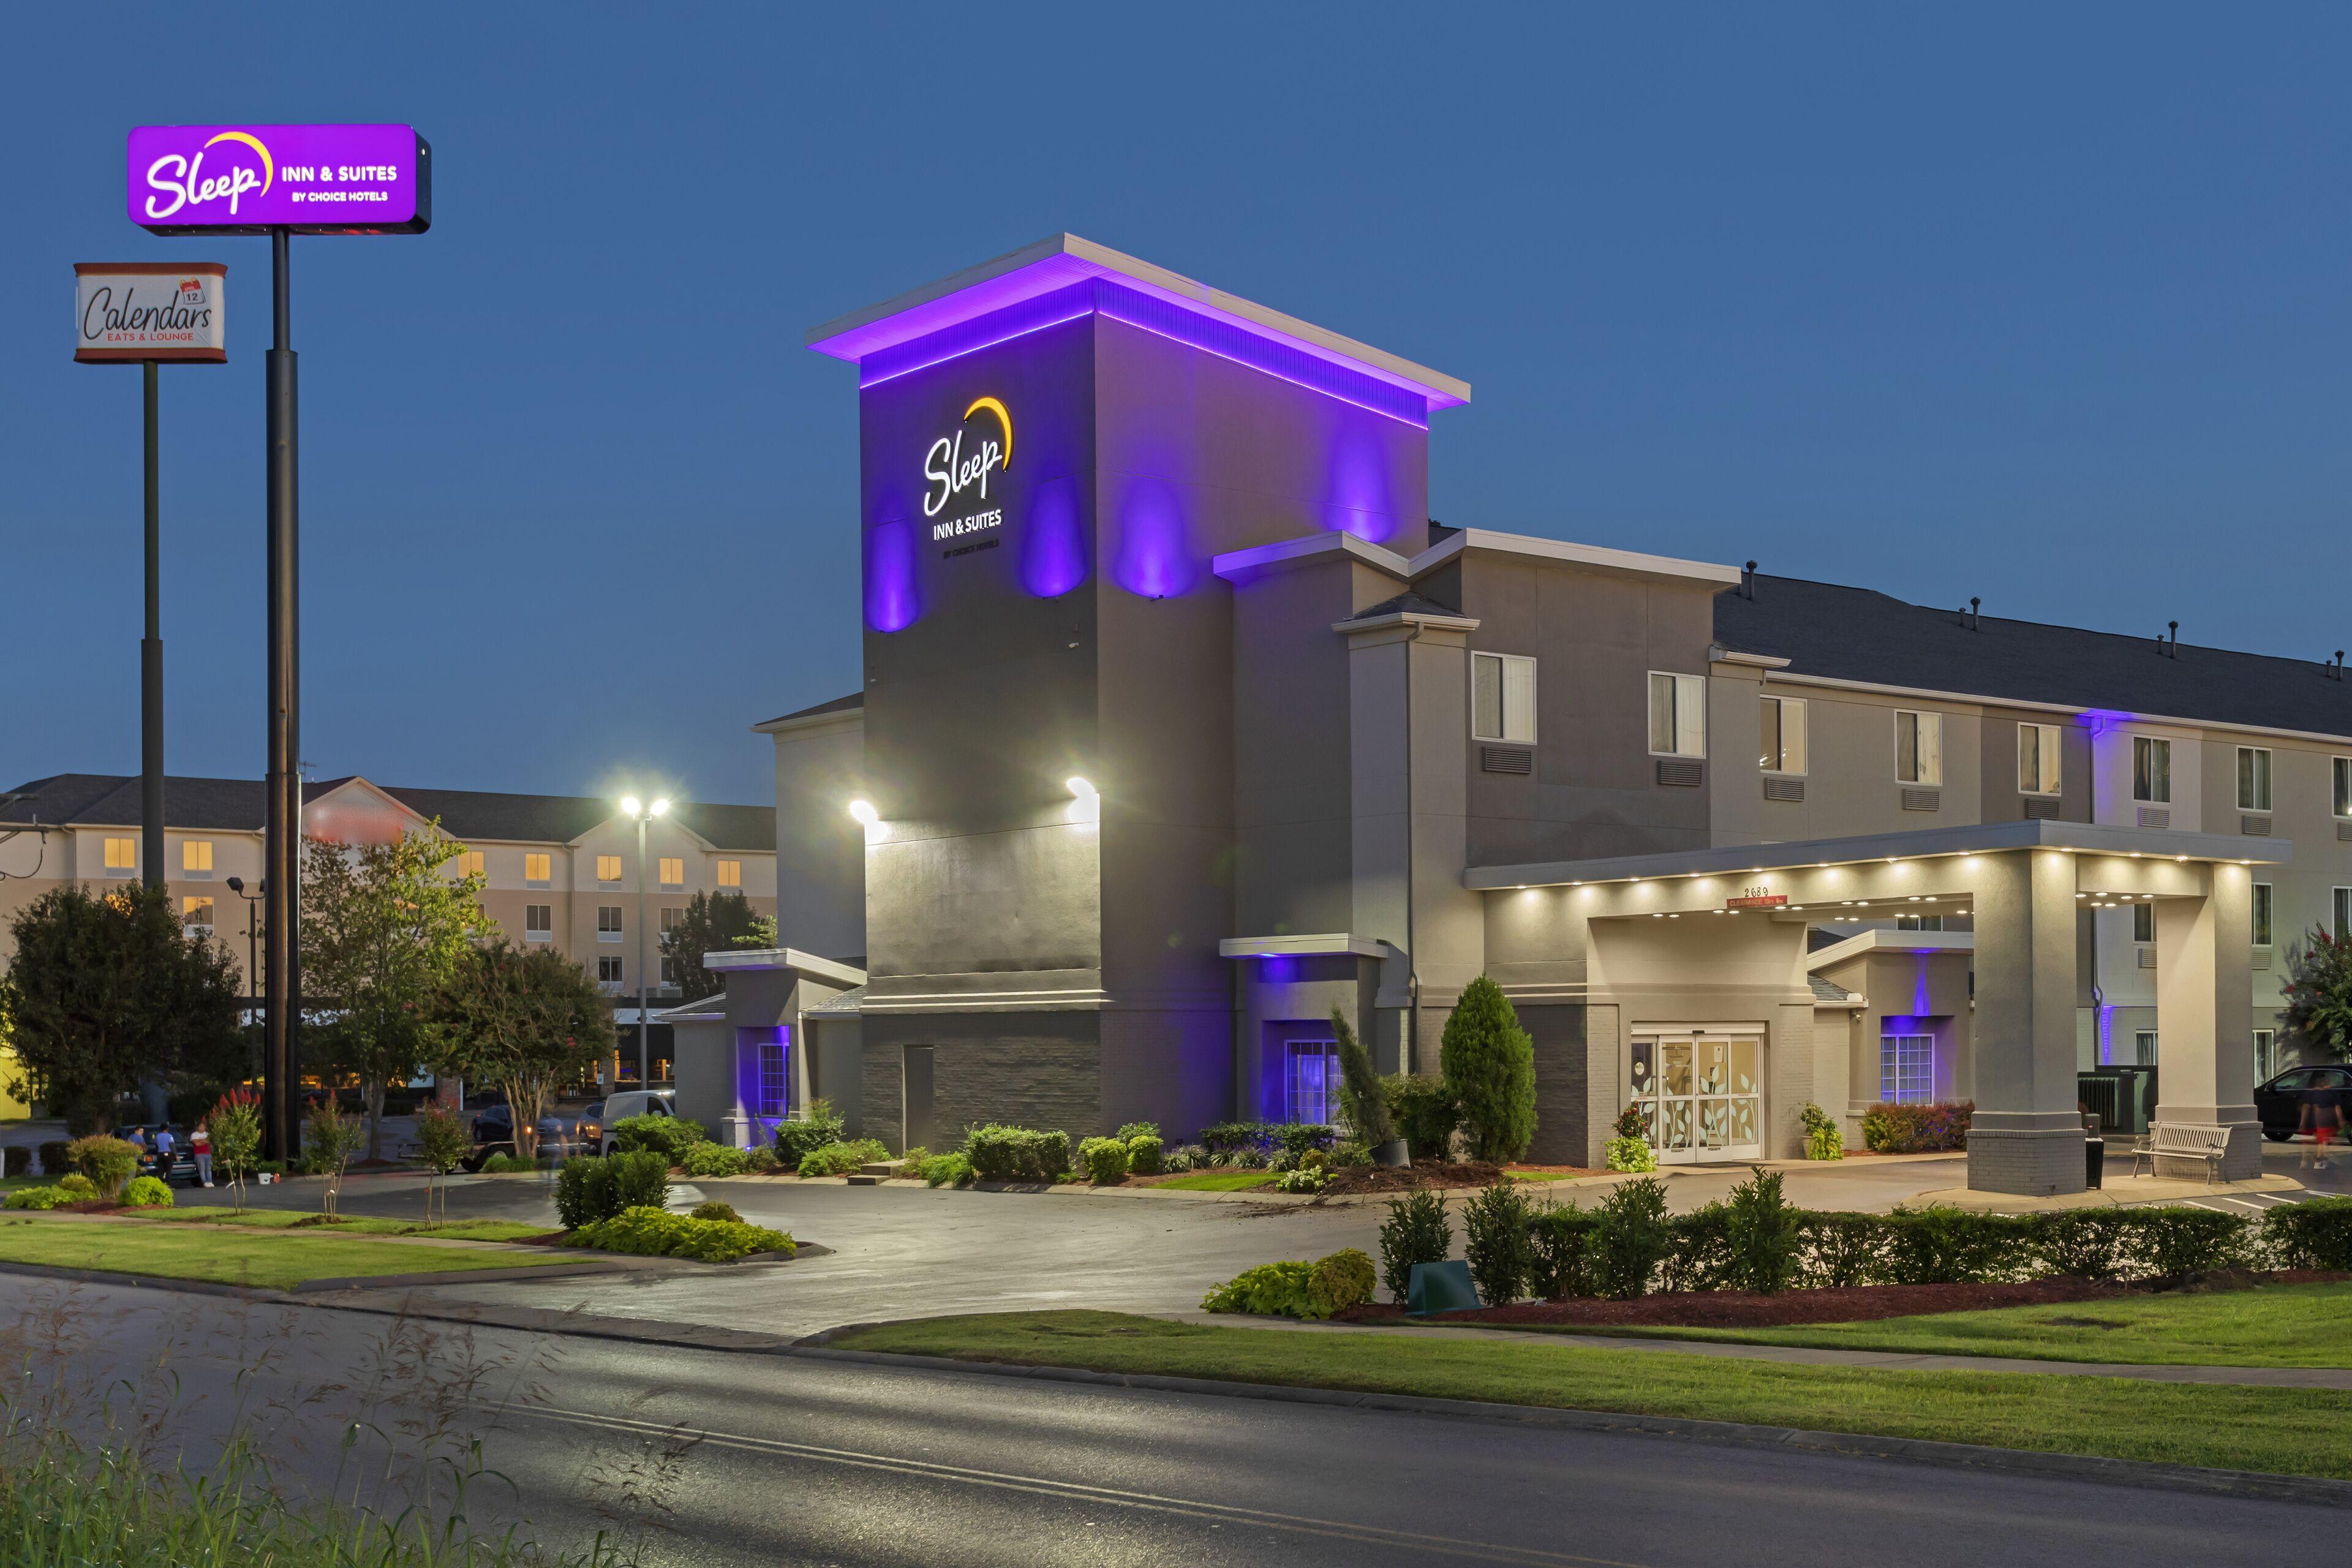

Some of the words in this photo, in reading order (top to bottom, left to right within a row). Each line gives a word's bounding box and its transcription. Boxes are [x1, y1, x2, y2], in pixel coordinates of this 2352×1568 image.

[282, 166, 314, 182] INN
[320, 166, 333, 182] &
[339, 165, 397, 181] SUITES
[145, 151, 262, 219] Sleep
[292, 192, 306, 202] BY
[307, 191, 347, 202] CHOICE
[349, 191, 388, 202] HOTELS
[187, 293, 198, 301] 12
[84, 287, 212, 340] Calendars
[107, 333, 135, 342] EATS
[139, 333, 146, 341] &
[150, 333, 194, 341] LOUNGE
[924, 429, 1003, 516] Sleep
[933, 521, 954, 541] INN
[956, 518, 964, 535] &
[965, 508, 1002, 533] SUITES
[1744, 886, 1768, 898] 2689
